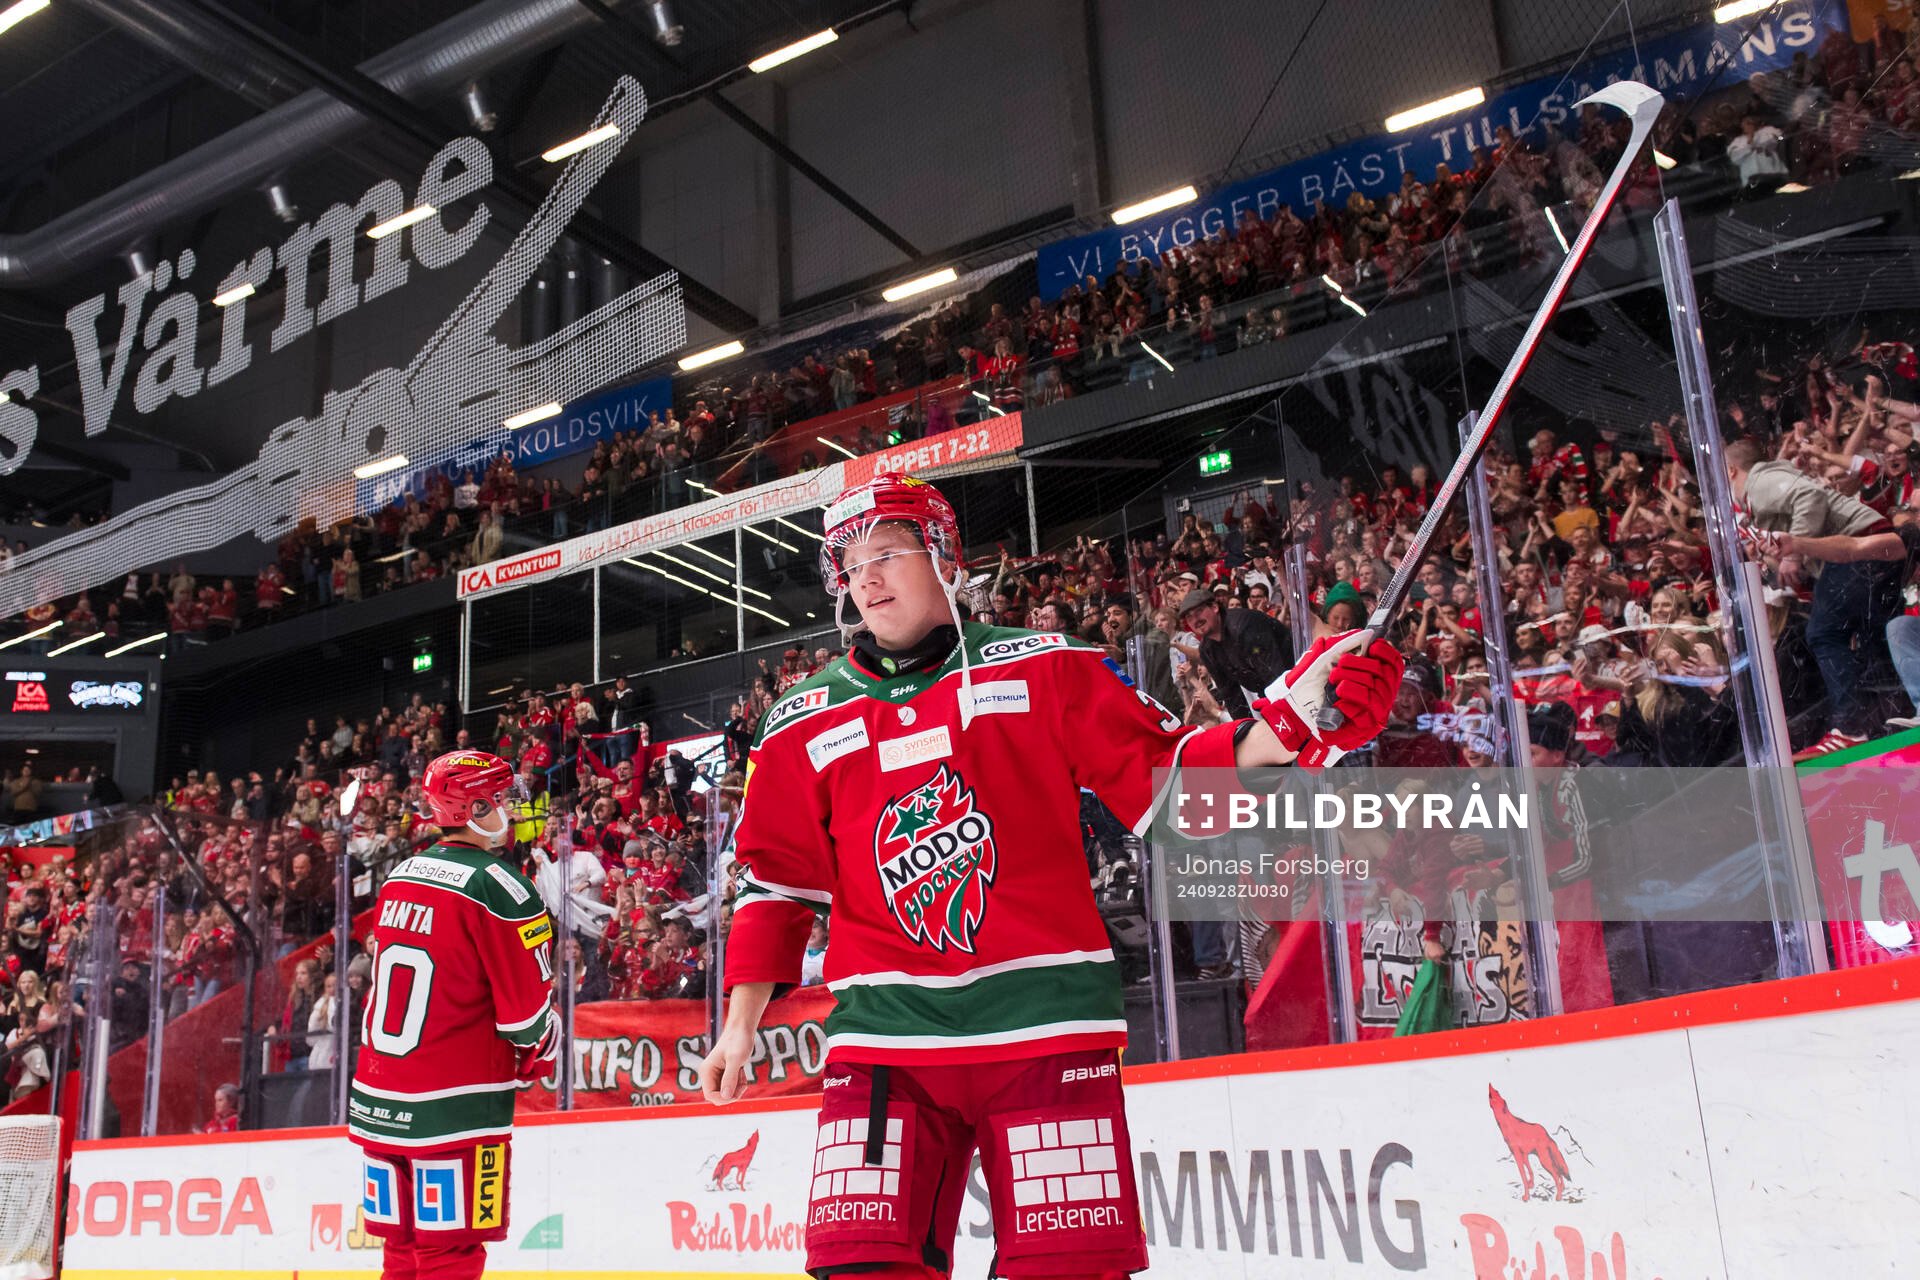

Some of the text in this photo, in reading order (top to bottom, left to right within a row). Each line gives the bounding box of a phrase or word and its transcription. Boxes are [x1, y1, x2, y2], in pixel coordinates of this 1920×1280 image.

[1301, 142, 1413, 208] BÄST
[65, 136, 494, 438] Värme
[873, 430, 991, 476] ÖPPET 7-22
[461, 570, 492, 595] ICA
[499, 555, 559, 580] KVANTUM
[739, 500, 759, 518] för
[17, 682, 47, 697] ICA
[889, 683, 918, 699] SHL
[978, 693, 1027, 704] ACTEMIUM
[822, 729, 865, 752] Thermion
[904, 732, 947, 752] SYNSAM
[882, 816, 985, 890] MODO
[411, 862, 466, 883] Högland
[904, 842, 984, 930] HOCKEY
[372, 1106, 391, 1120] BIL
[394, 1111, 414, 1123] AB
[809, 1200, 897, 1227] Lerstenen.
[1015, 1205, 1124, 1234] Lerstenen.
